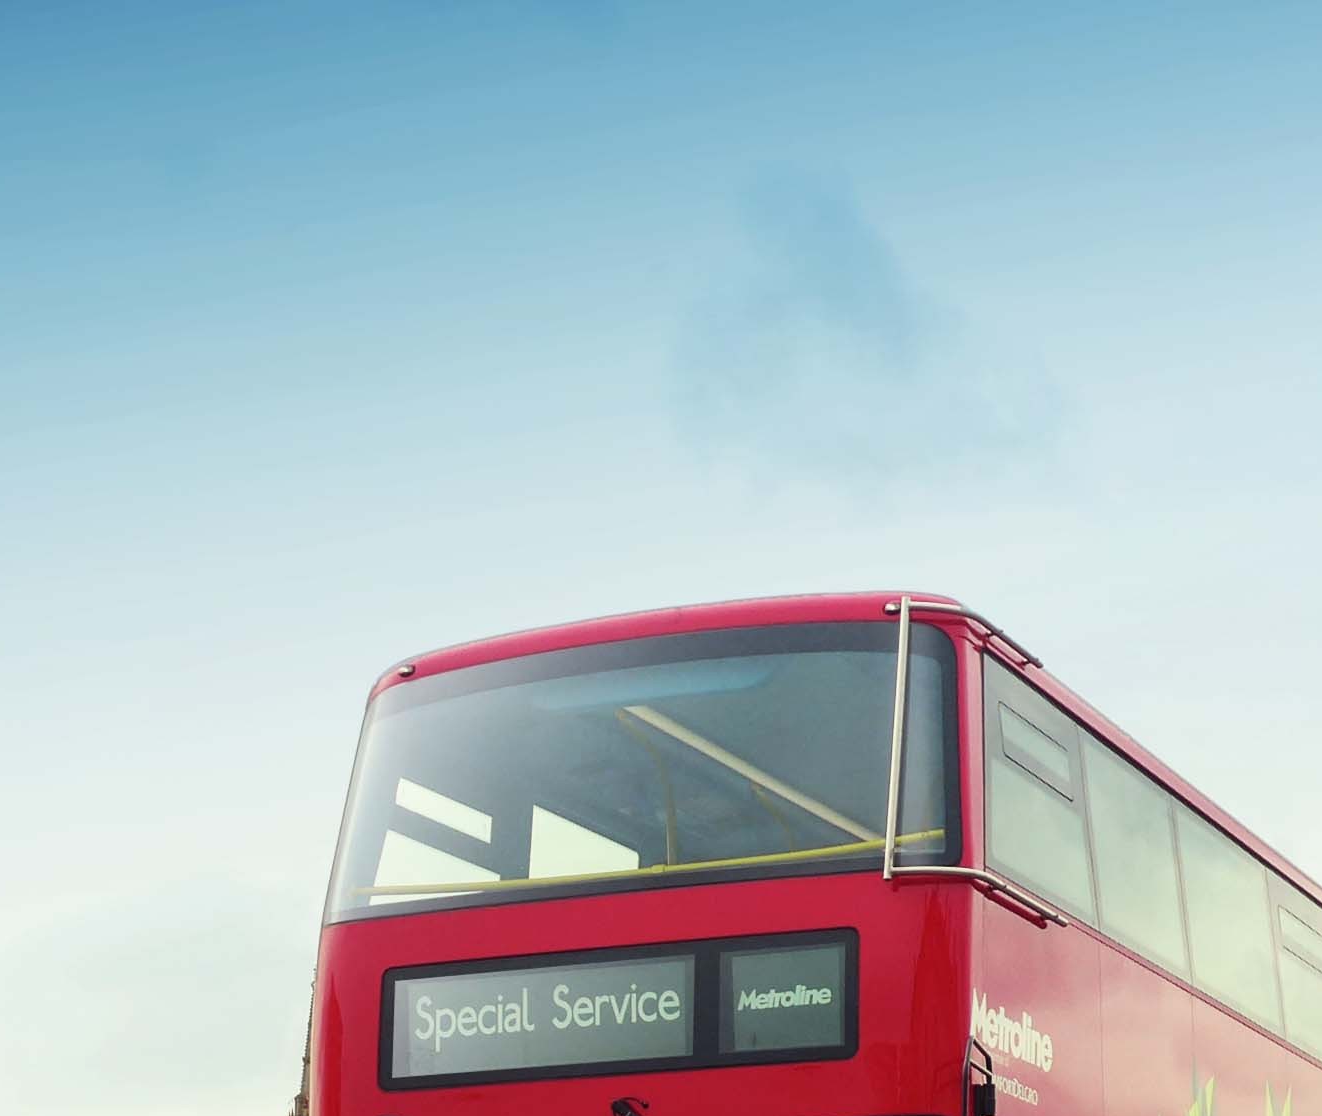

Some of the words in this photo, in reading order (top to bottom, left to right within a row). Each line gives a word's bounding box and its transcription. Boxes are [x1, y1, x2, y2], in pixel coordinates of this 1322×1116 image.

[414, 987, 535, 1053] Special
[551, 983, 681, 1029] Service
[737, 984, 833, 1012] Metroline
[970, 987, 1054, 1073] Metroline
